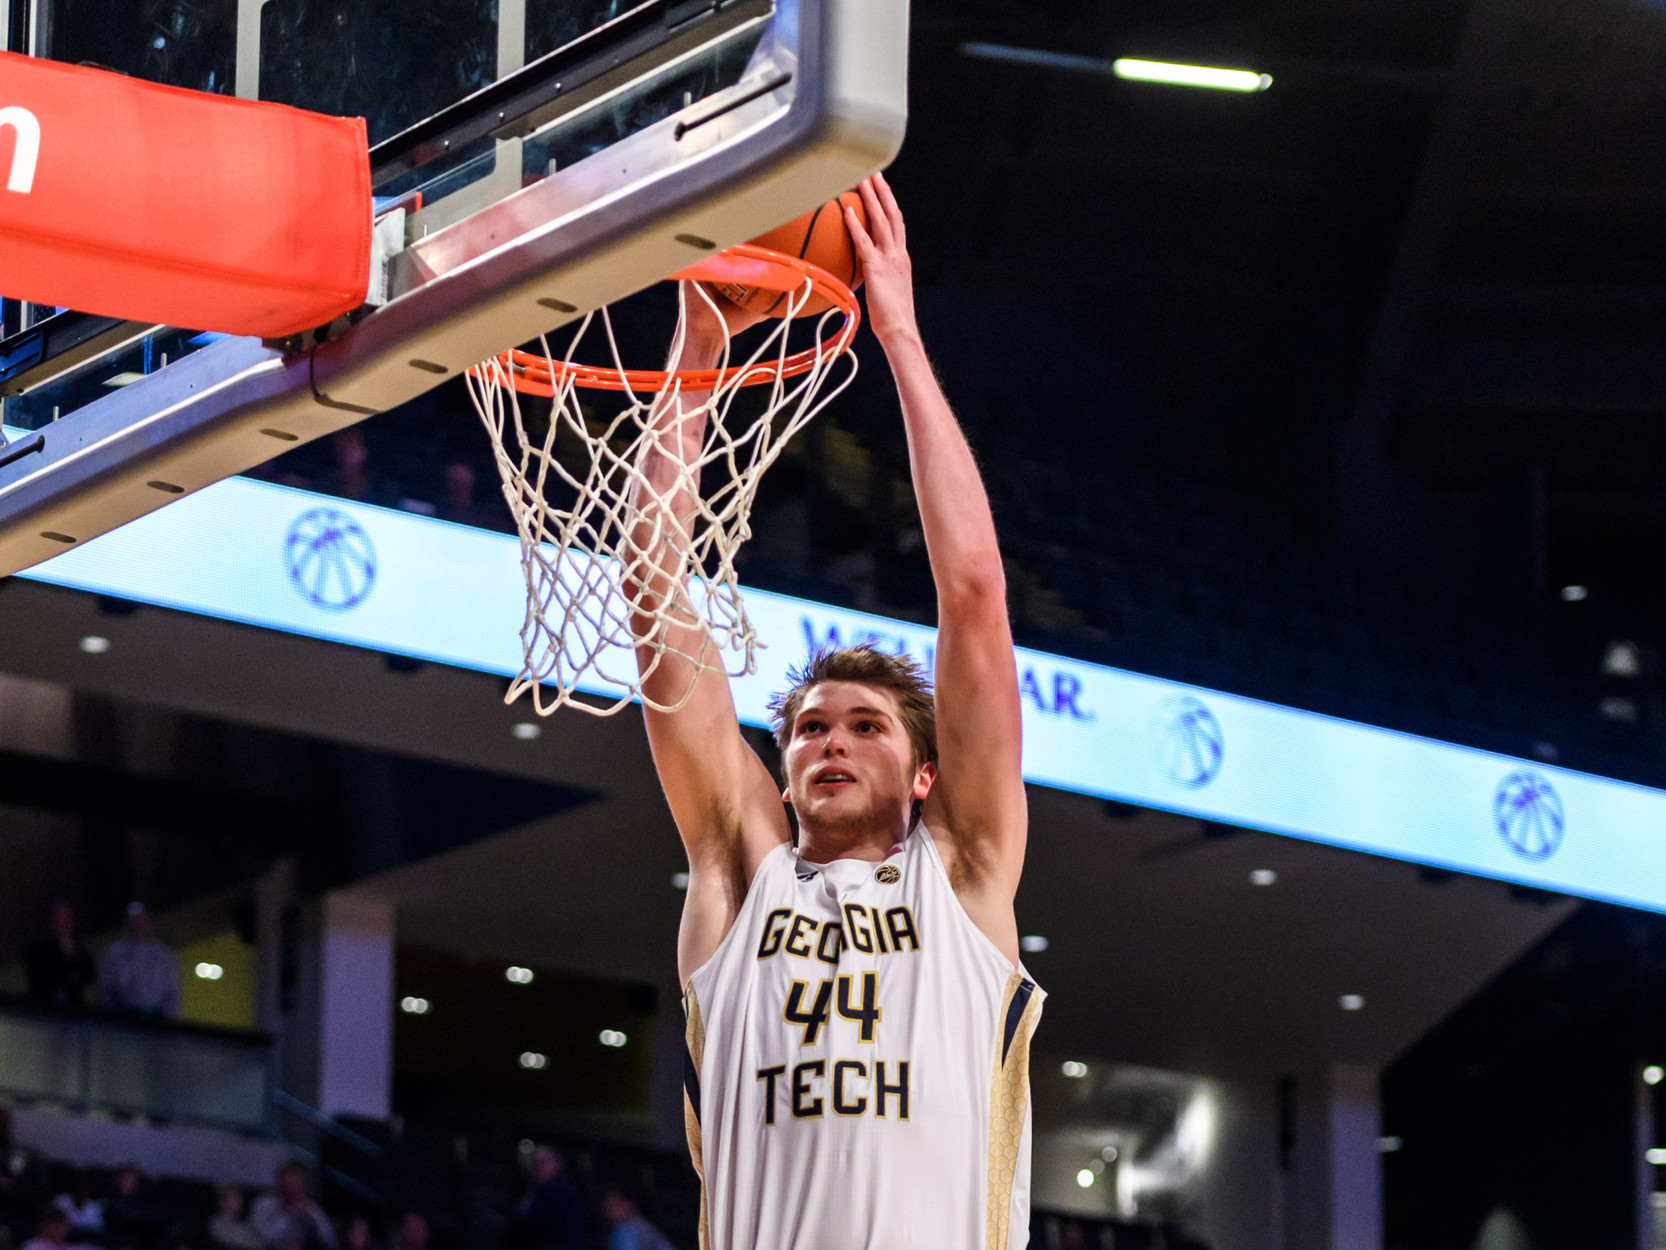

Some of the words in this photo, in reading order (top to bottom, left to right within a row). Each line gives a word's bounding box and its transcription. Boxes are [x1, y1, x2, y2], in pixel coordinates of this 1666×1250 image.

[757, 903, 920, 965] GEOGIA
[783, 971, 882, 1046] 44
[757, 1059, 911, 1126] TECH
